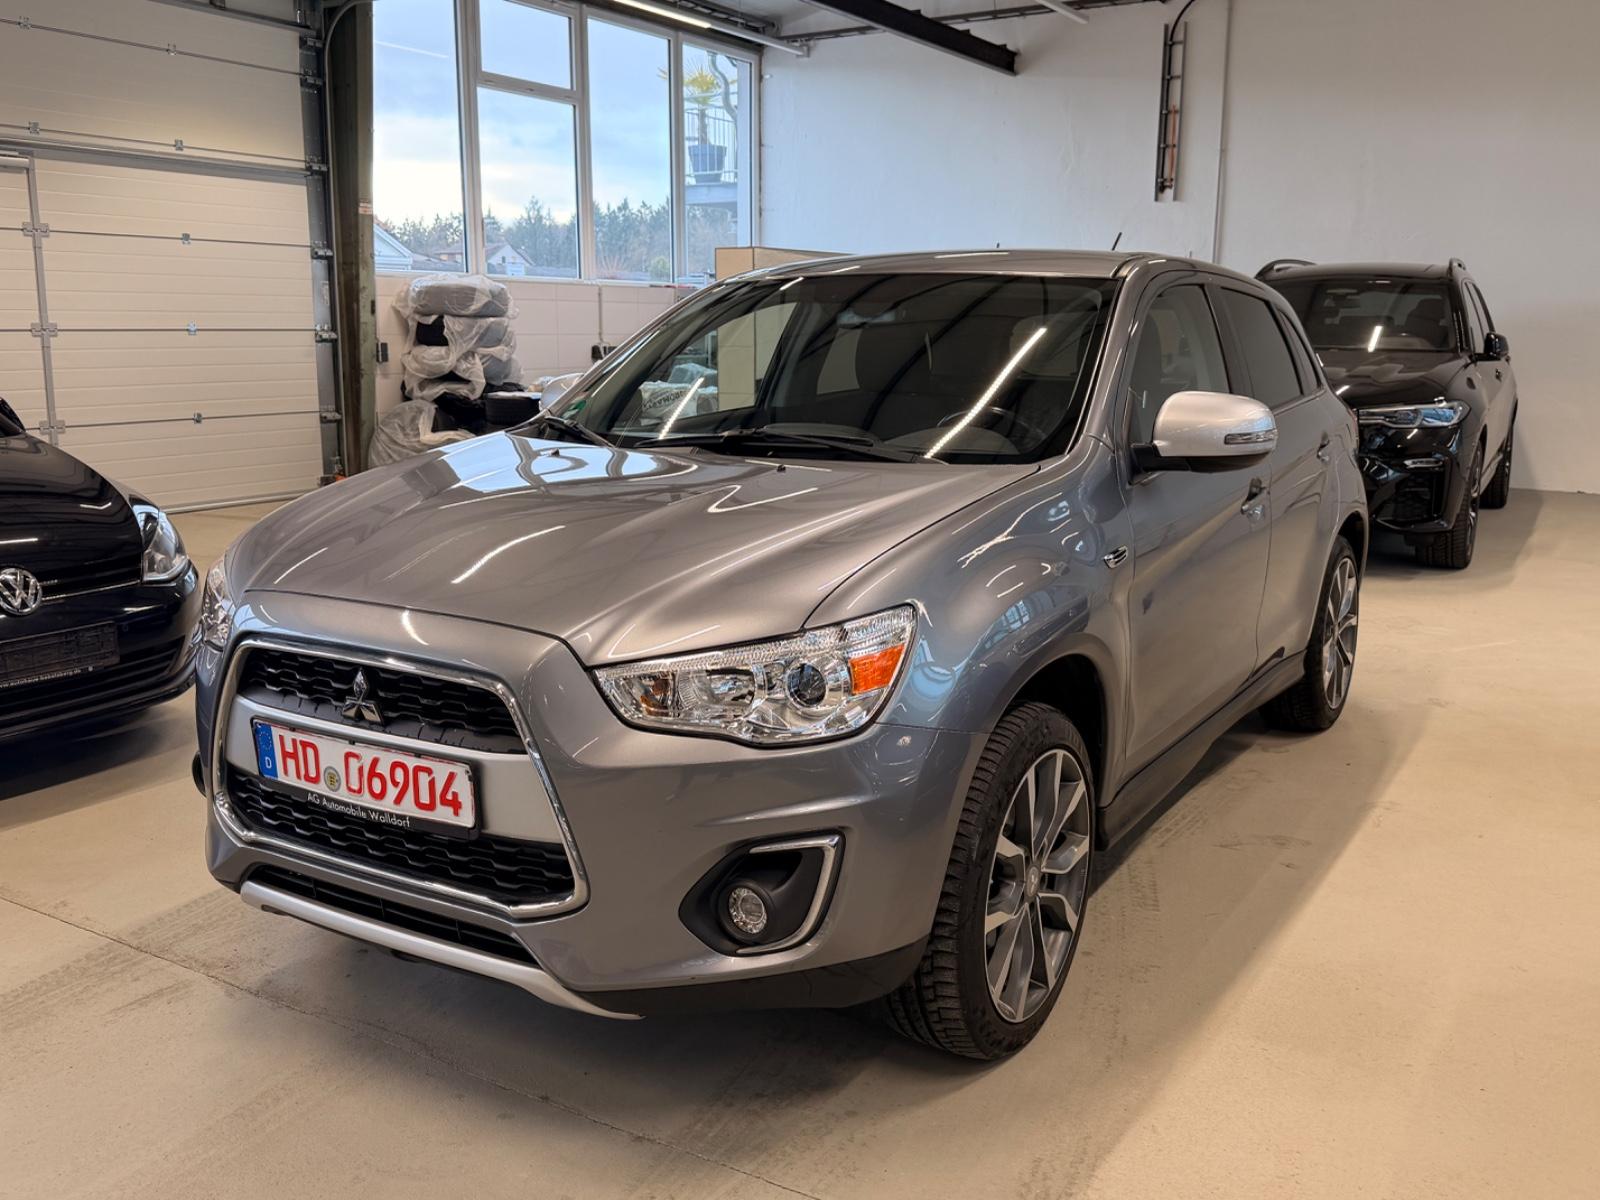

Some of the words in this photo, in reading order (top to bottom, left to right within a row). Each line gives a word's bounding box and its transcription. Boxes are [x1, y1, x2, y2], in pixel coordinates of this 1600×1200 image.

[264, 756, 272, 769] D
[278, 734, 321, 785] HD
[343, 751, 463, 817] 06904
[307, 792, 320, 804] AG
[322, 797, 368, 819] Automobile
[368, 809, 411, 828] Walldorf
